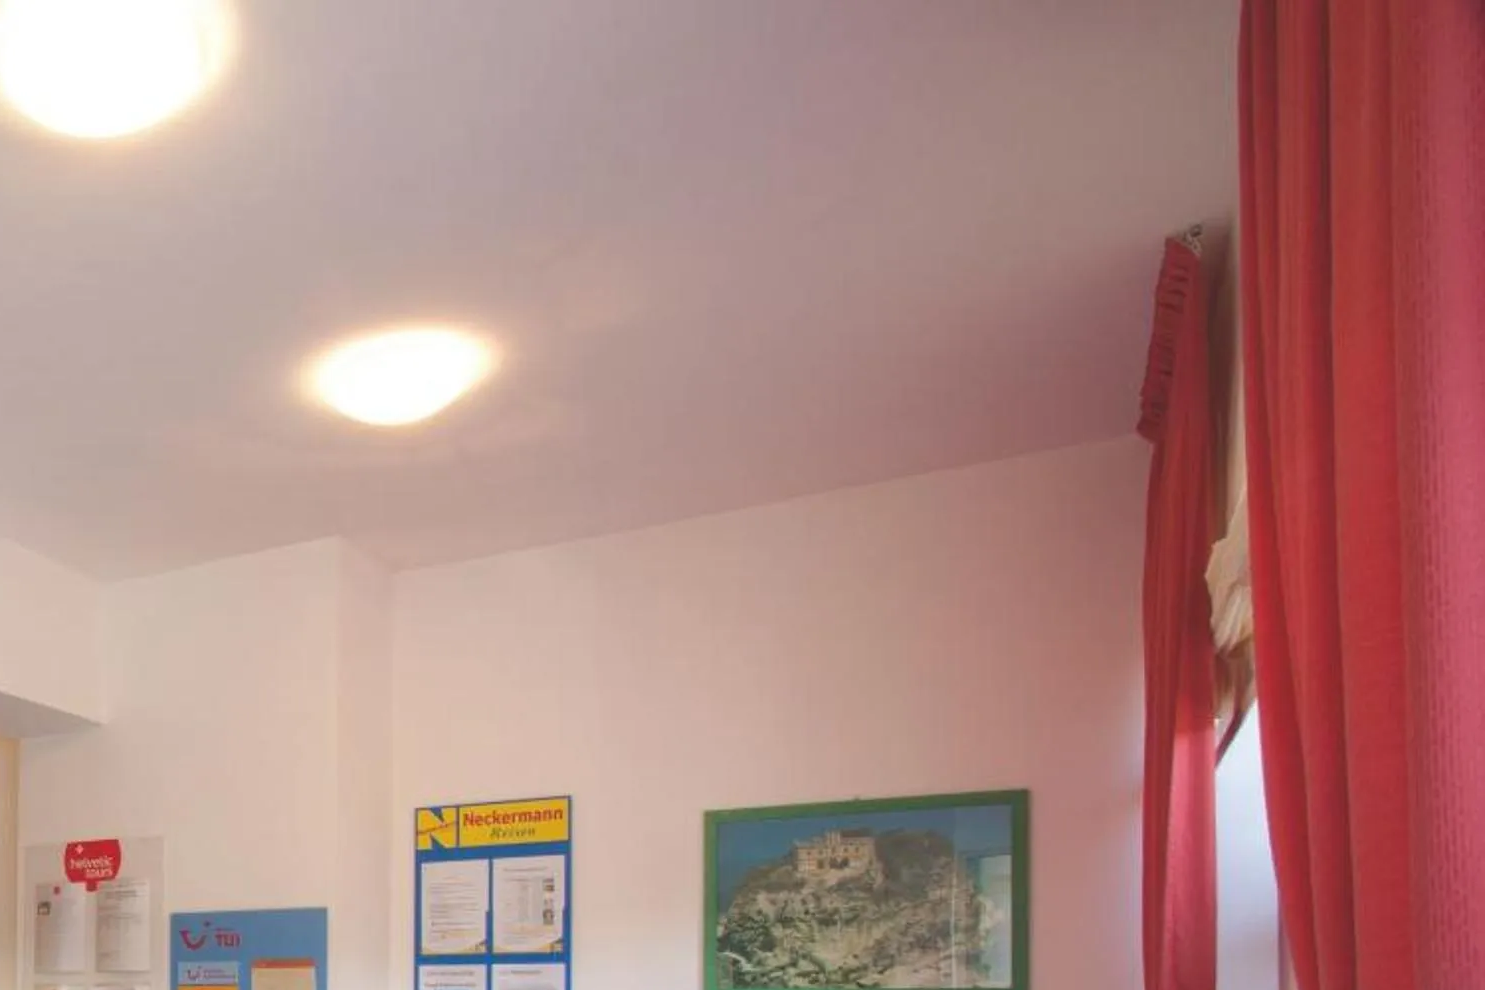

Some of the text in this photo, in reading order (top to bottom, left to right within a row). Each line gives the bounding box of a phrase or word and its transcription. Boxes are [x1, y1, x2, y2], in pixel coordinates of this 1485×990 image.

[463, 808, 564, 827] Neckermann
[70, 855, 115, 870] helvetic
[214, 932, 242, 948] TUI
